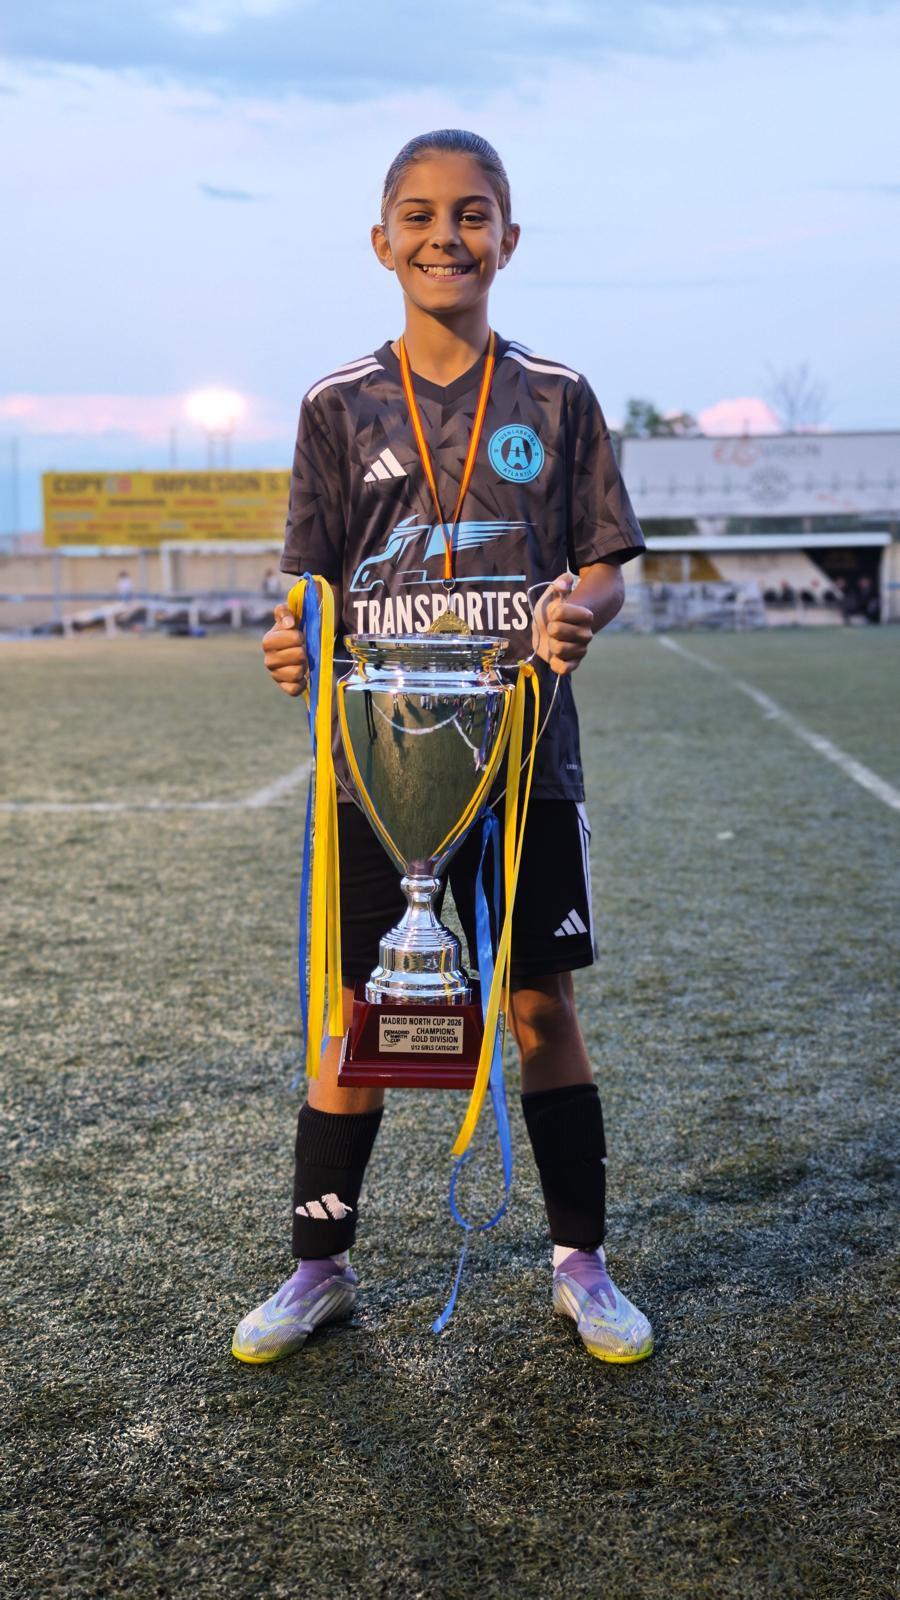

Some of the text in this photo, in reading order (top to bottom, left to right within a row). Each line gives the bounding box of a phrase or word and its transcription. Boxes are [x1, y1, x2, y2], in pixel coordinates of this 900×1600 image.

[353, 591, 529, 634] TRANSPORTES
[381, 1017, 462, 1027] MADRID NORTH CUP 2026
[416, 1027, 456, 1036] CHAMPIONS
[411, 1035, 459, 1044] GOLD DIVISION
